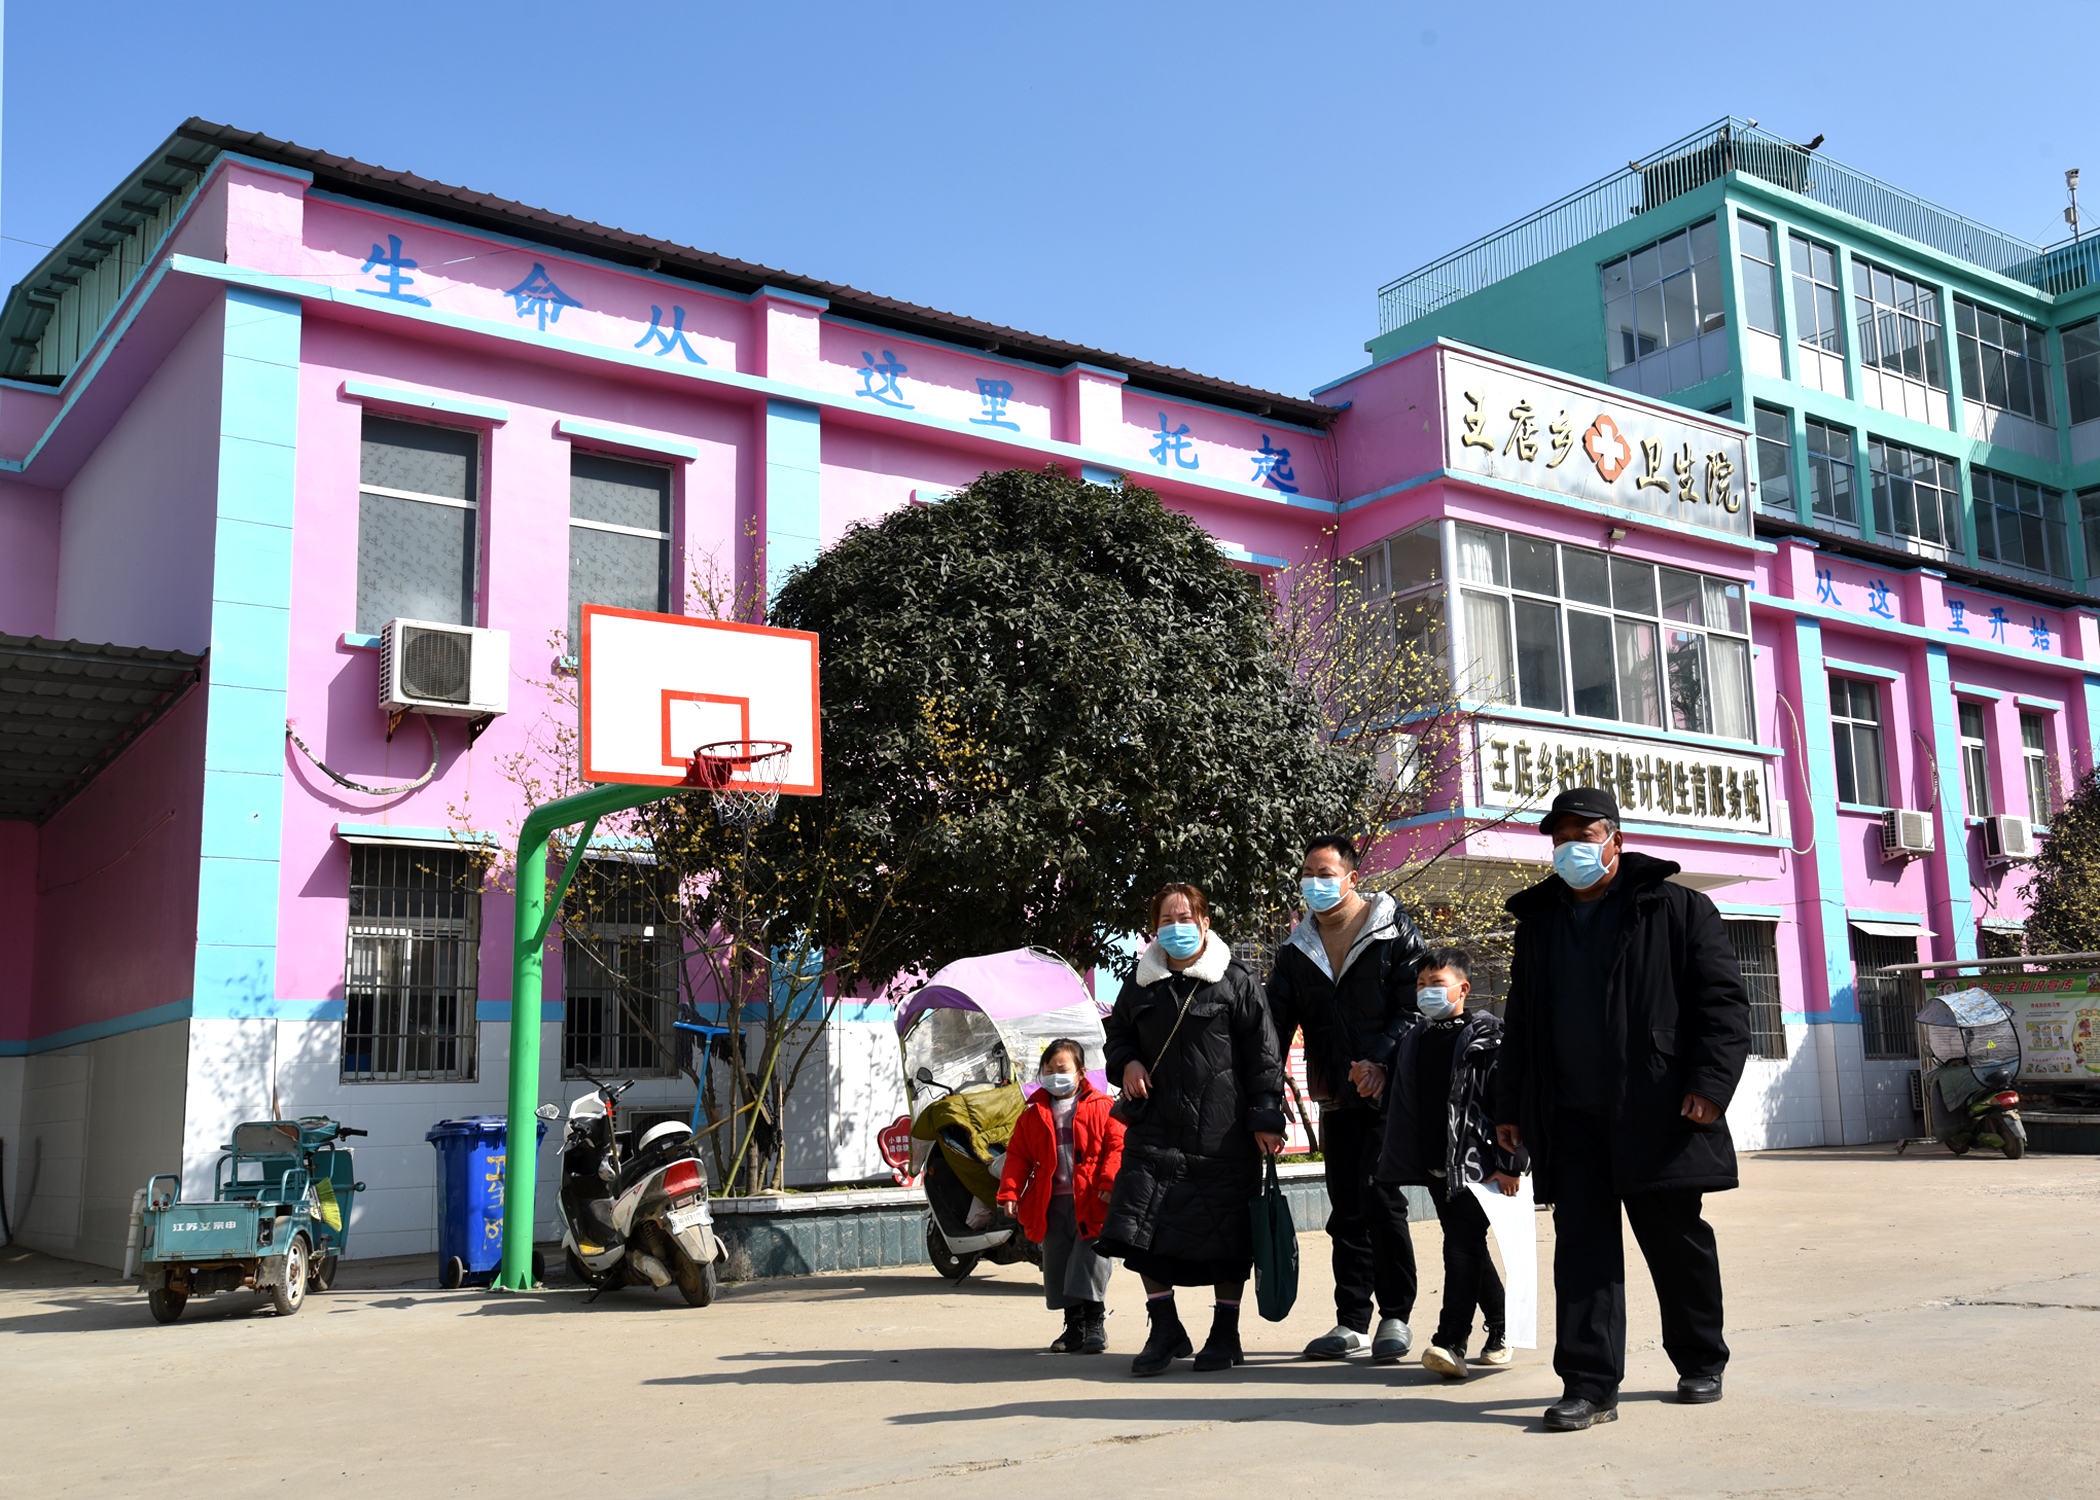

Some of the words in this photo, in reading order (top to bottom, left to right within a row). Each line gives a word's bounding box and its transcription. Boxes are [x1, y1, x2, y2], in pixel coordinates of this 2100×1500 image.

[356, 233, 1298, 494] 生命从这里托起
[1462, 386, 1574, 468] 王店乡
[1636, 436, 1741, 513] 卫生院
[1816, 569, 2050, 651] 从这里开始
[172, 1222, 198, 1232] 江苏
